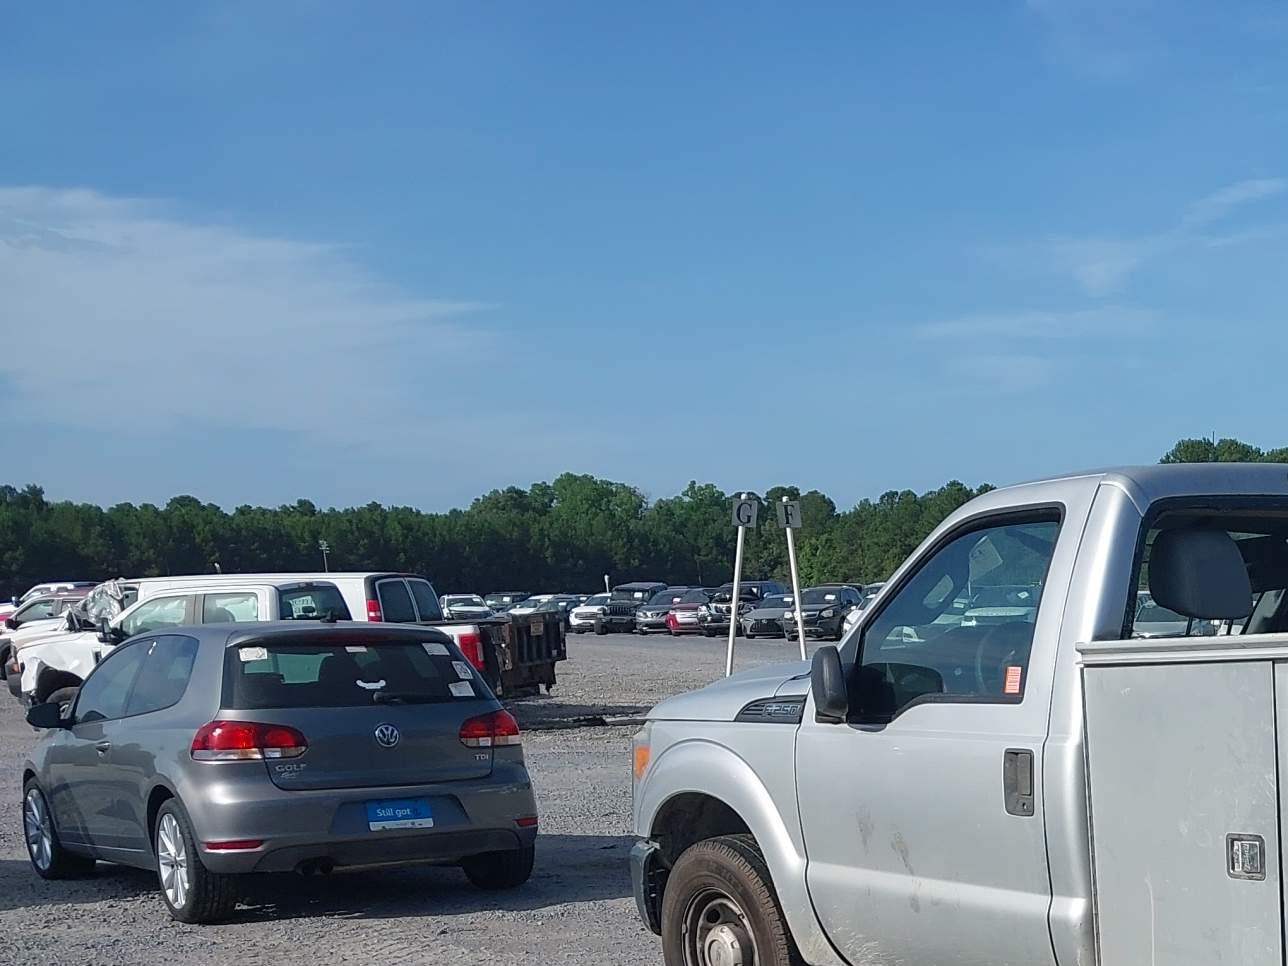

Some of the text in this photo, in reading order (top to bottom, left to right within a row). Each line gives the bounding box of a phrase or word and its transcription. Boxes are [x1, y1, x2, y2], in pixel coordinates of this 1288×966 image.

[736, 502, 753, 524] G
[783, 504, 795, 525] F
[275, 763, 307, 772] GOLF
[376, 807, 394, 817] Still
